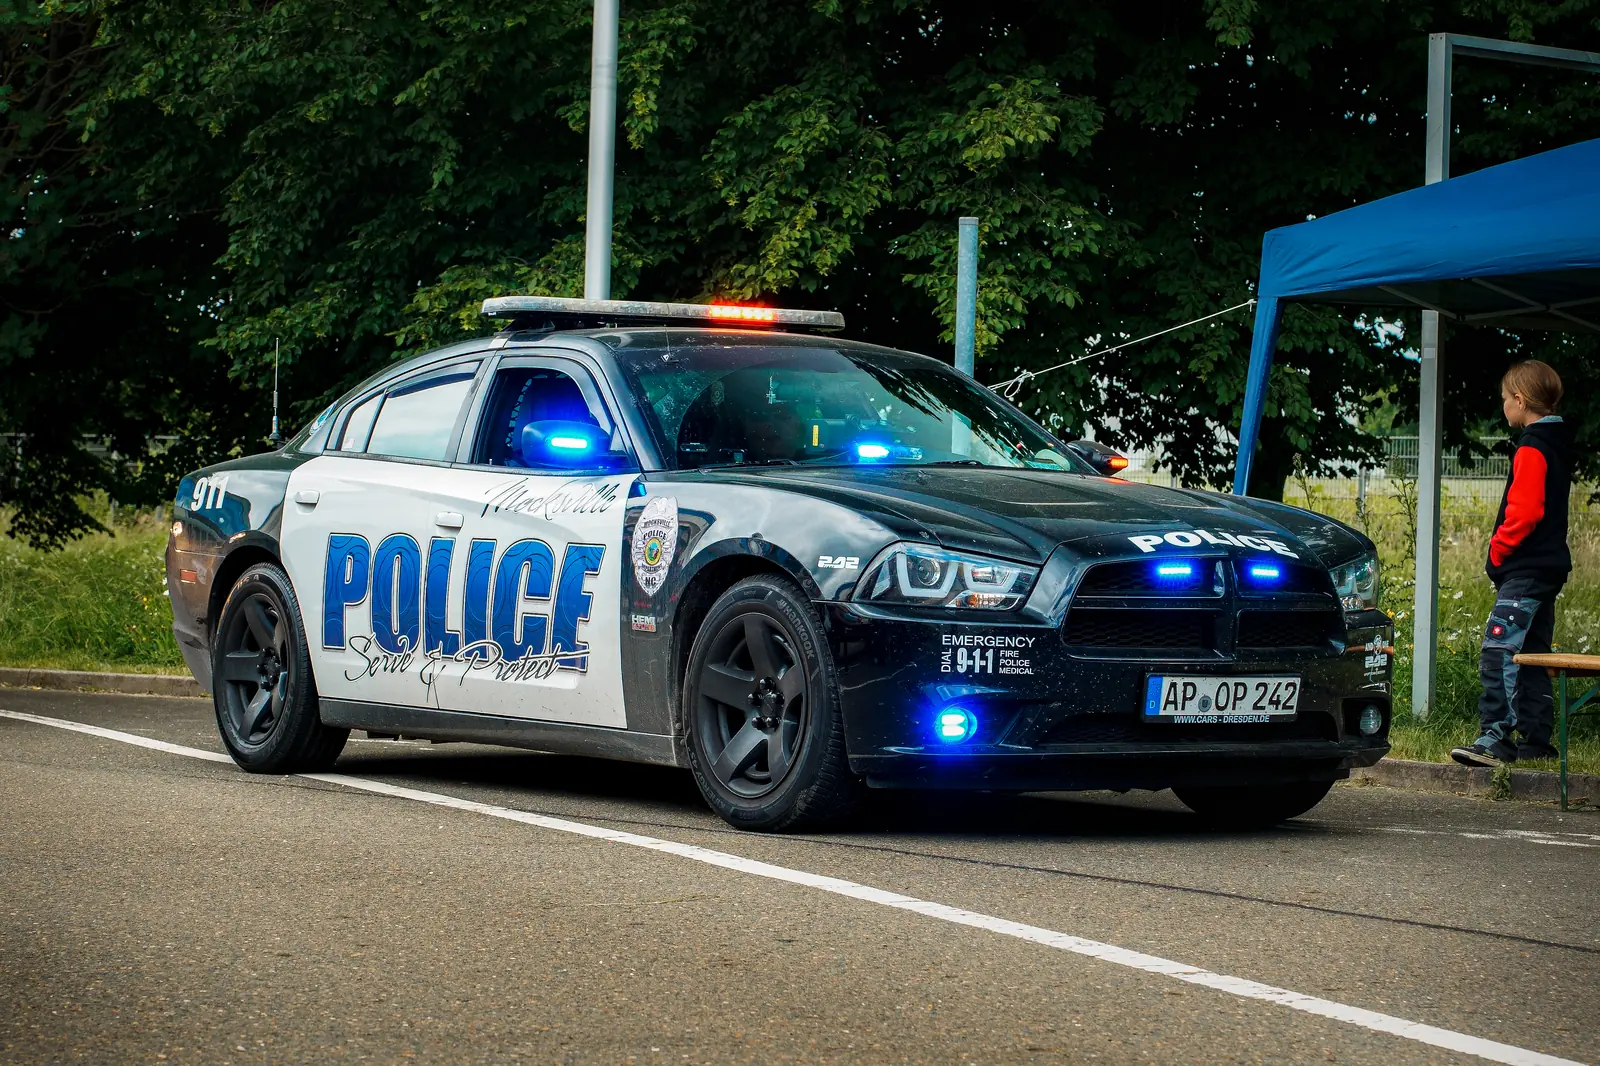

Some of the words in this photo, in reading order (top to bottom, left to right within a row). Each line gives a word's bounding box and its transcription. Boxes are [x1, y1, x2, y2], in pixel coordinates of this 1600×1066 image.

[190, 476, 229, 511] 911
[480, 477, 620, 521] Mocksville
[643, 529, 667, 541] POLICE
[1127, 529, 1300, 560] POLICE
[817, 555, 860, 569] 242
[645, 576, 657, 585] NC
[321, 532, 607, 673] POLICE
[942, 634, 1036, 648] EMERGENCY
[344, 633, 414, 682] Serve
[454, 639, 591, 687] Protect
[940, 648, 952, 673] DIAL
[956, 647, 995, 674] 9-1-1
[999, 649, 1020, 658] FIRE
[999, 658, 1030, 667] POLICE
[998, 667, 1035, 675] MEDICAL
[1162, 681, 1197, 711] AP
[1214, 681, 1248, 711] OP
[1252, 681, 1297, 711] 242
[1149, 700, 1156, 709] D
[1173, 715, 1218, 724] WWW.CARS
[1222, 714, 1270, 724] DRESDEN.DE
